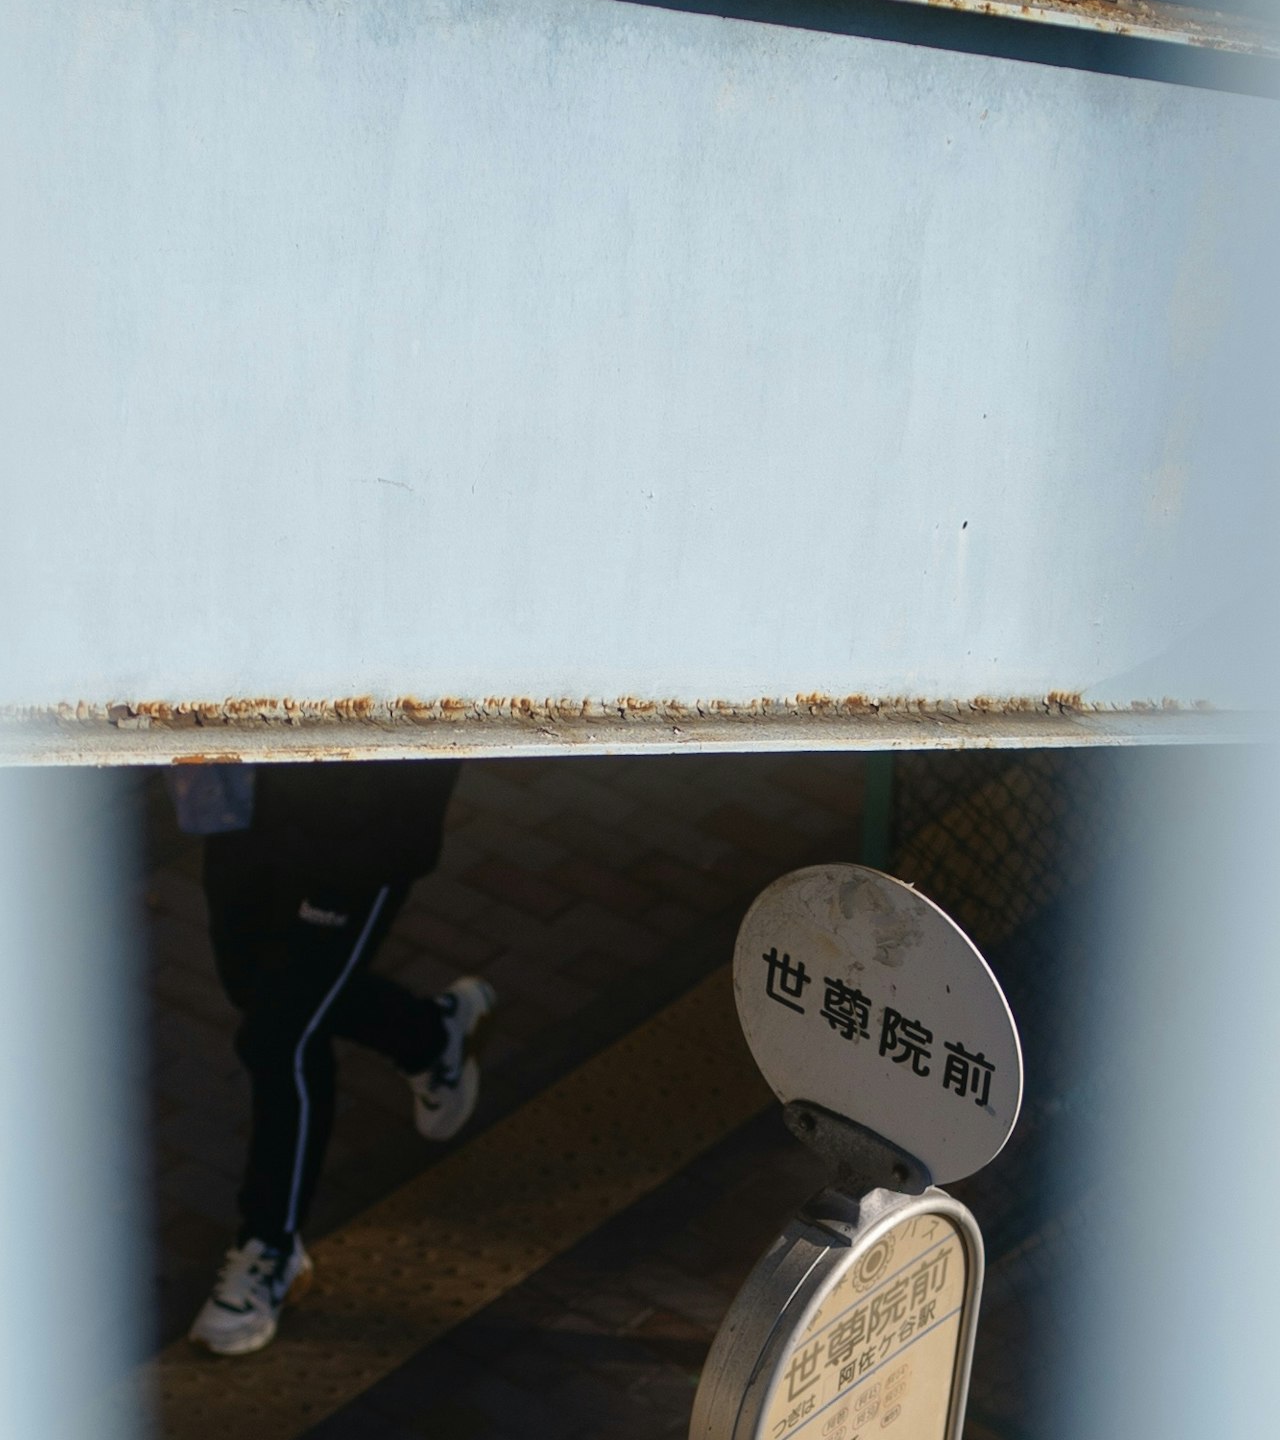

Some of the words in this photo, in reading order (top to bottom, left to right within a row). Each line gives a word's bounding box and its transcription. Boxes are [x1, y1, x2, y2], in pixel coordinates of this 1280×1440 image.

[762, 947, 995, 1108] 世尊院前
[784, 1248, 953, 1402] 世尊院前
[772, 1396, 816, 1439] つぎは
